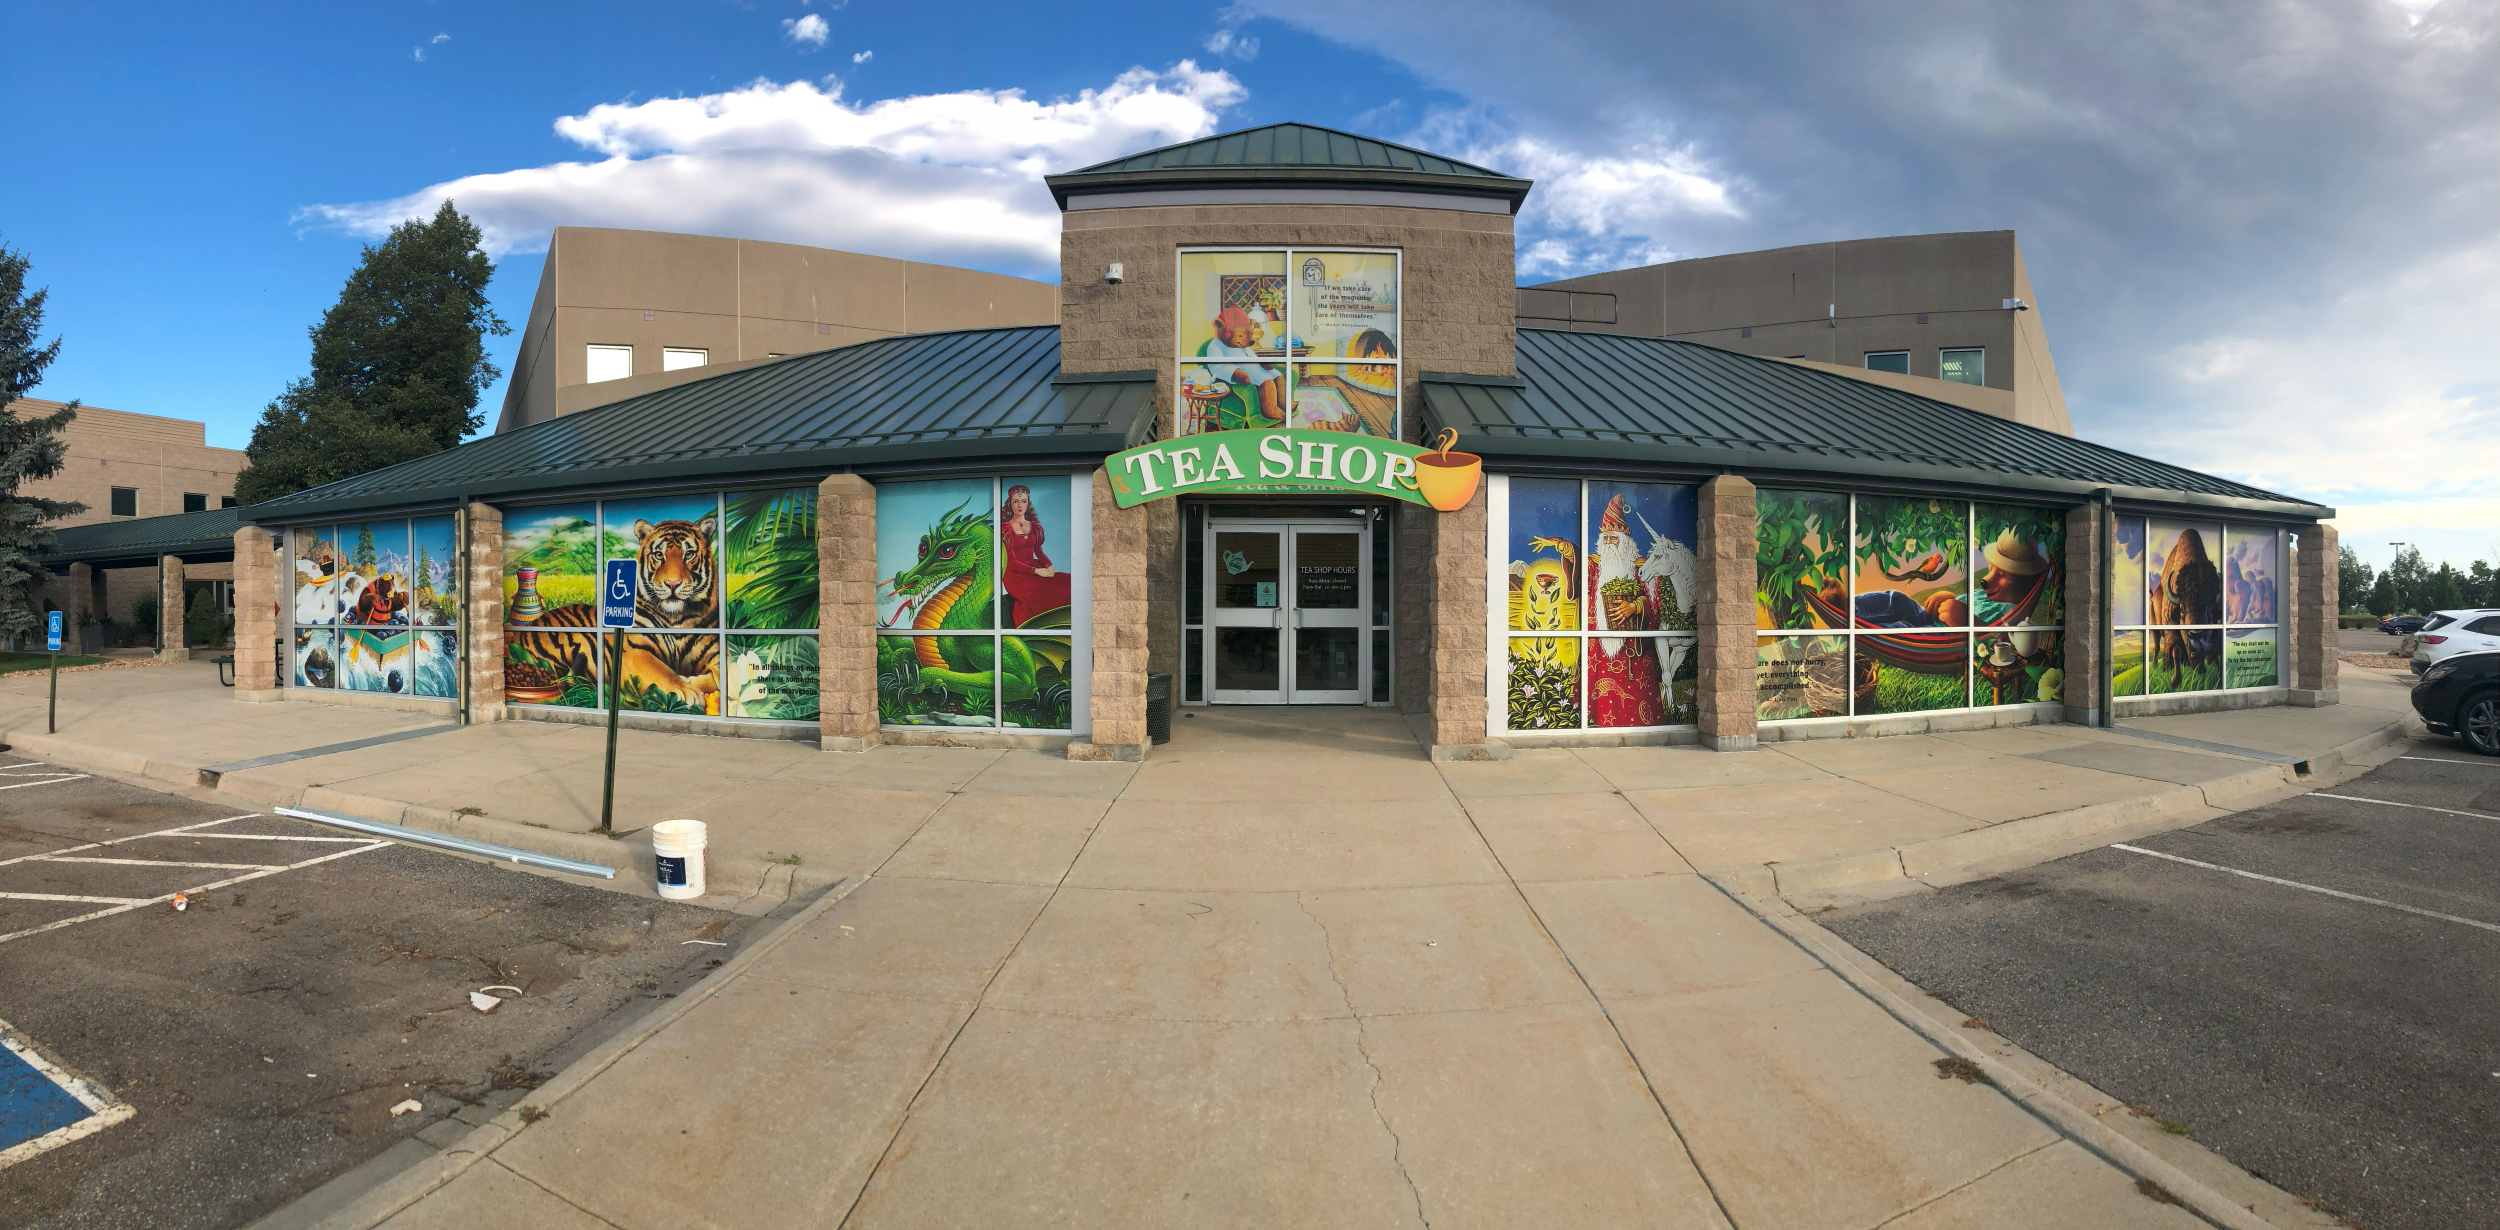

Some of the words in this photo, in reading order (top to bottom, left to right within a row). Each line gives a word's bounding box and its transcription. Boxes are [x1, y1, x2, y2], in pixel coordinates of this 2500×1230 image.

[1124, 443, 1245, 497] TEA
[1258, 434, 1417, 491] SHOP
[605, 606, 634, 618] PARKING
[1771, 658, 1789, 667] does
[1805, 658, 1826, 667] hurry,
[761, 663, 770, 671] all
[772, 663, 794, 673] things
[795, 663, 804, 672] of
[1770, 670, 1809, 680] everything
